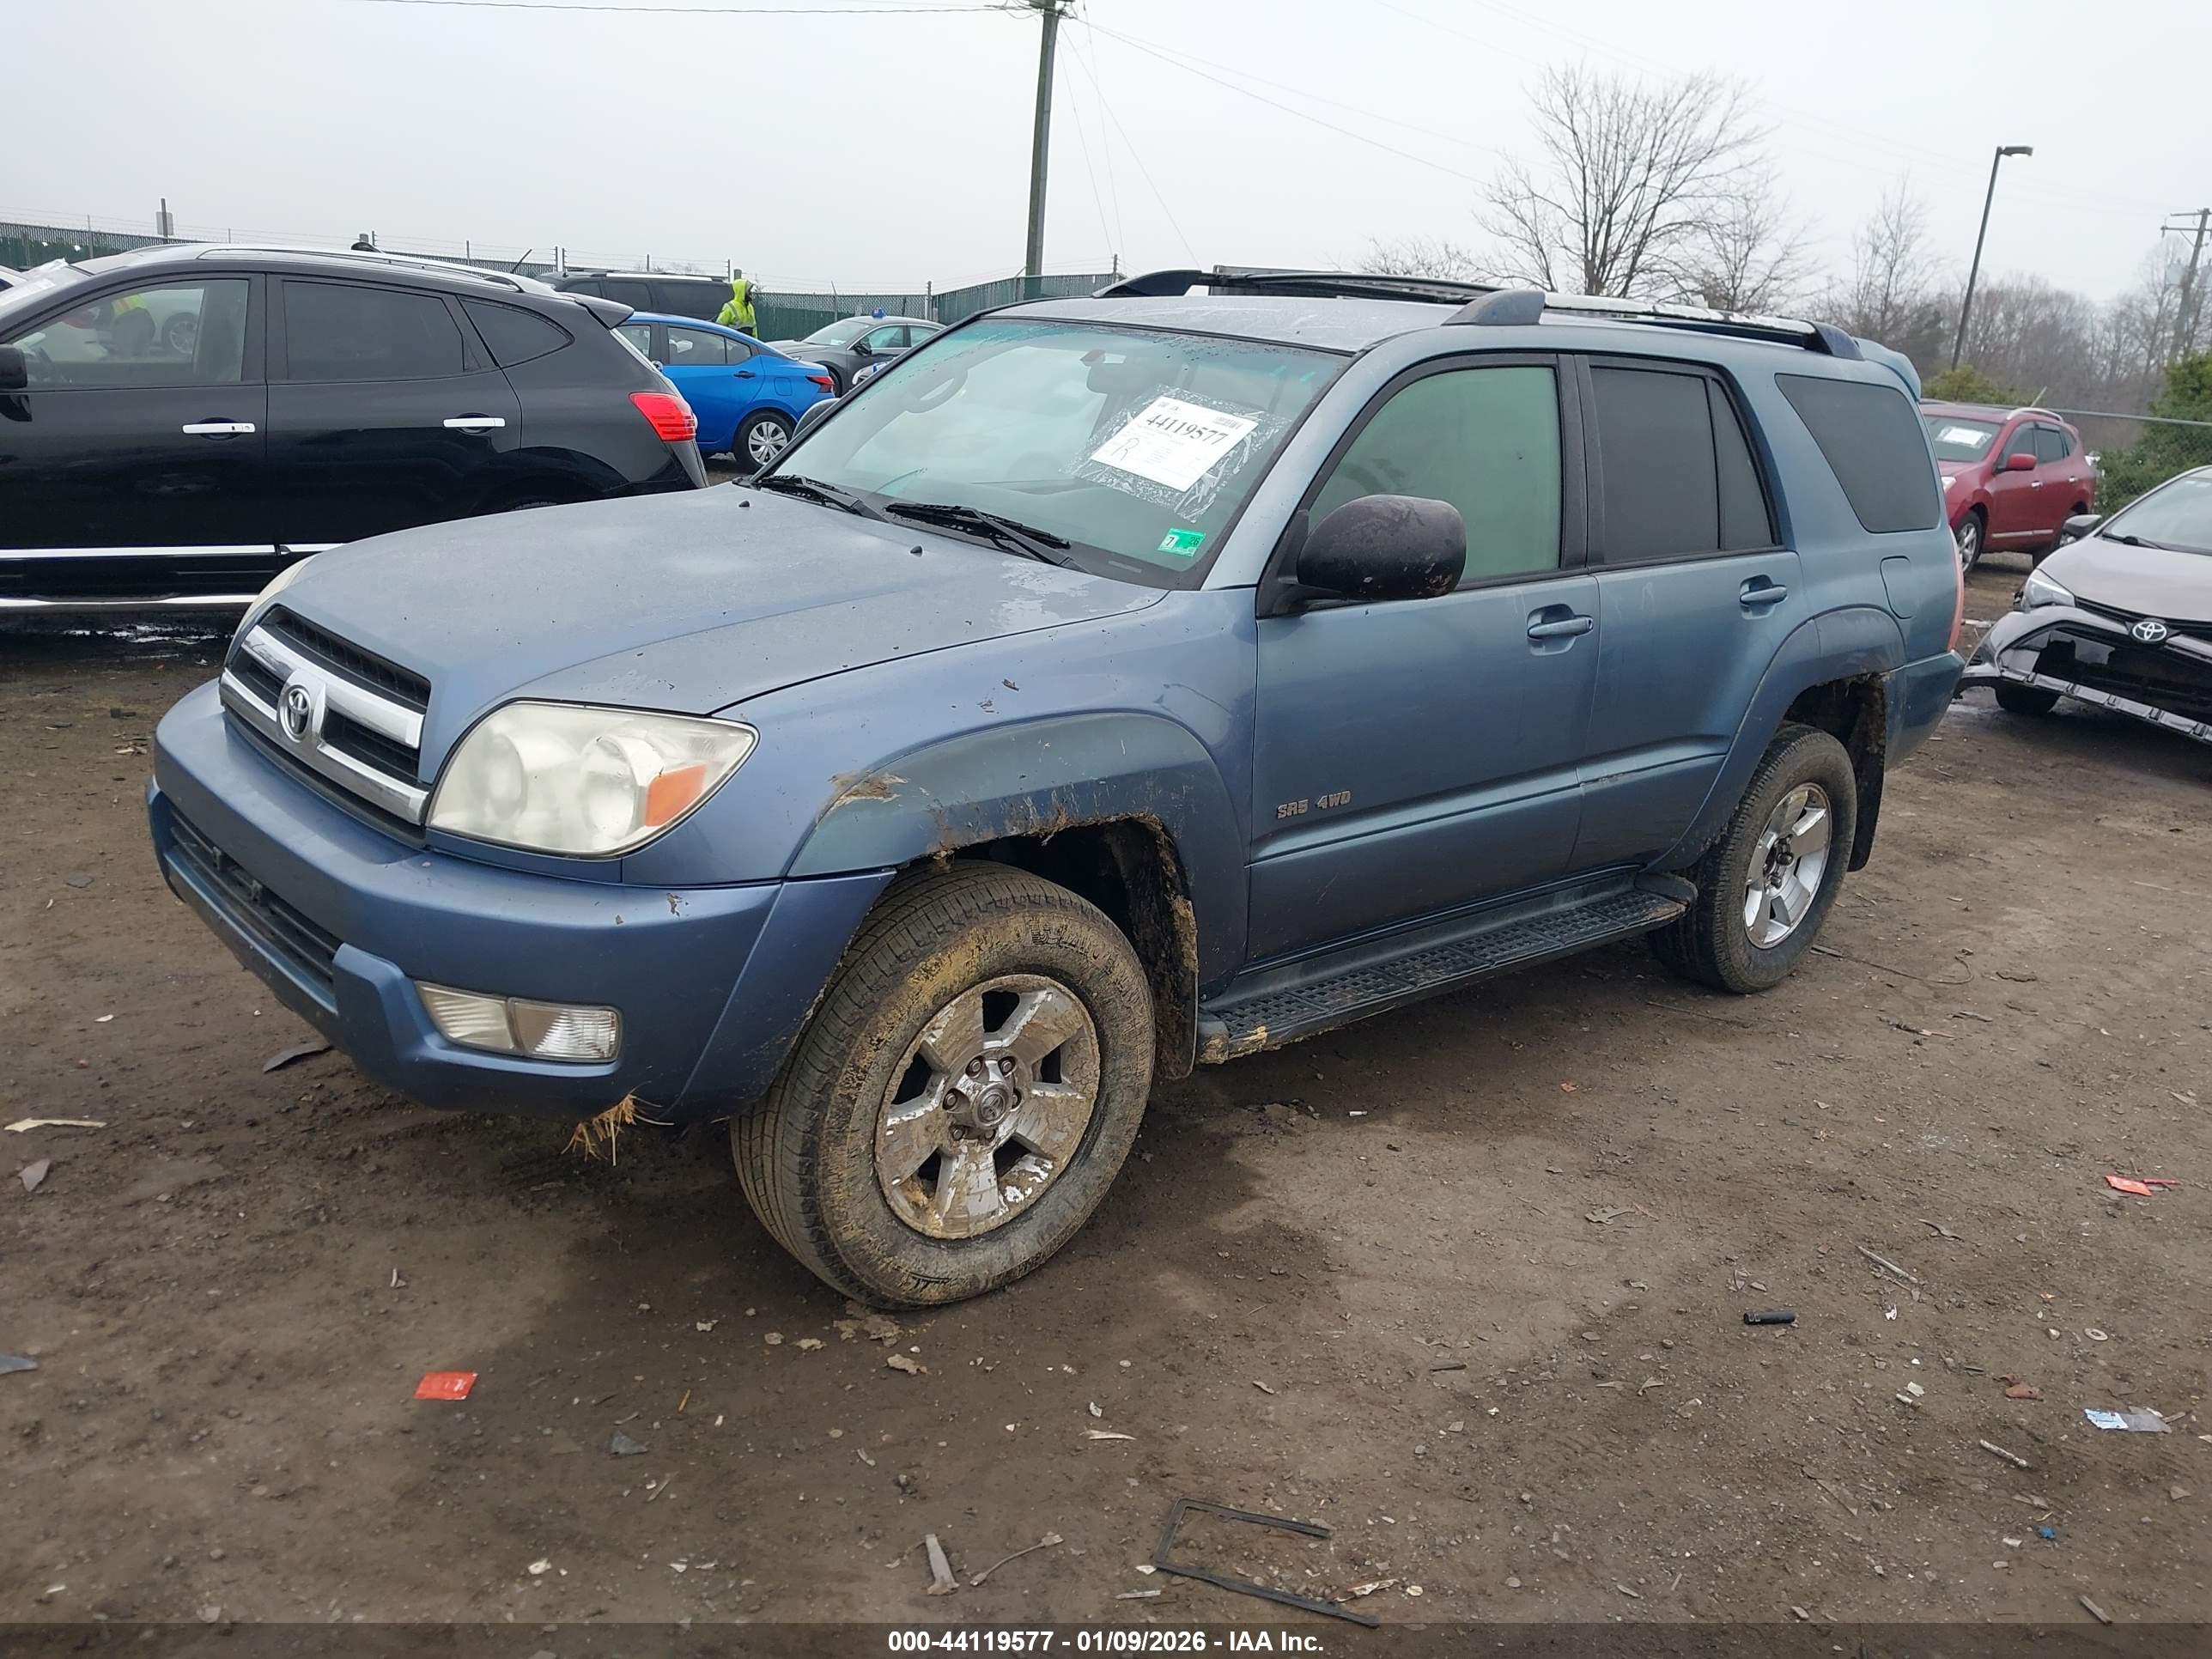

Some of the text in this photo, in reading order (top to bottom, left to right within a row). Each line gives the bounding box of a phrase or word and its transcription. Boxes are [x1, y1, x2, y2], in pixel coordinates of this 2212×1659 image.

[1146, 414, 1229, 446] 44119577
[1166, 536, 1176, 546] 7
[1277, 790, 1351, 819] SR5 4WD
